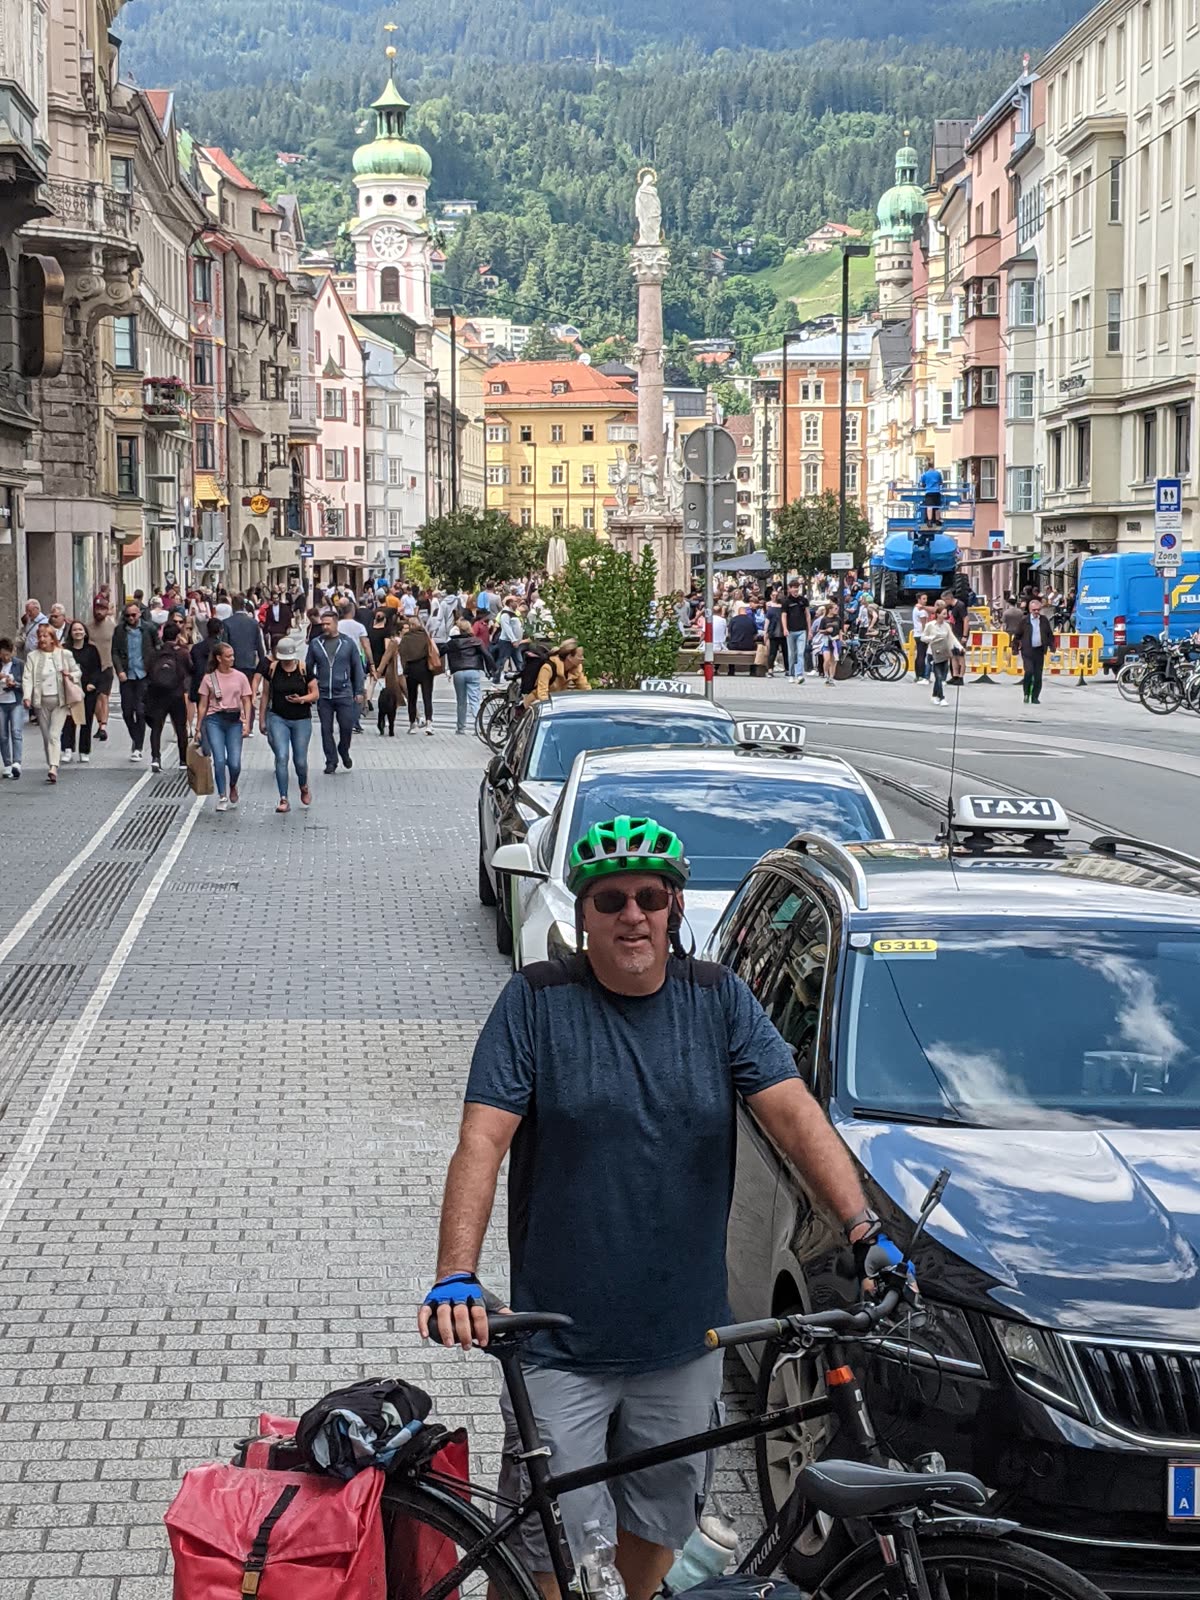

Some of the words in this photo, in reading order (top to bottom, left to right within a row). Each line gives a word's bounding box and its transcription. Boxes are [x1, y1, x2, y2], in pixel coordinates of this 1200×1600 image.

[1158, 552, 1178, 560] Zone
[649, 681, 685, 694] TAXI
[746, 724, 796, 743] TAXI
[974, 799, 1051, 816] TAXI
[879, 941, 933, 951] 5311
[1179, 1497, 1189, 1509] A
